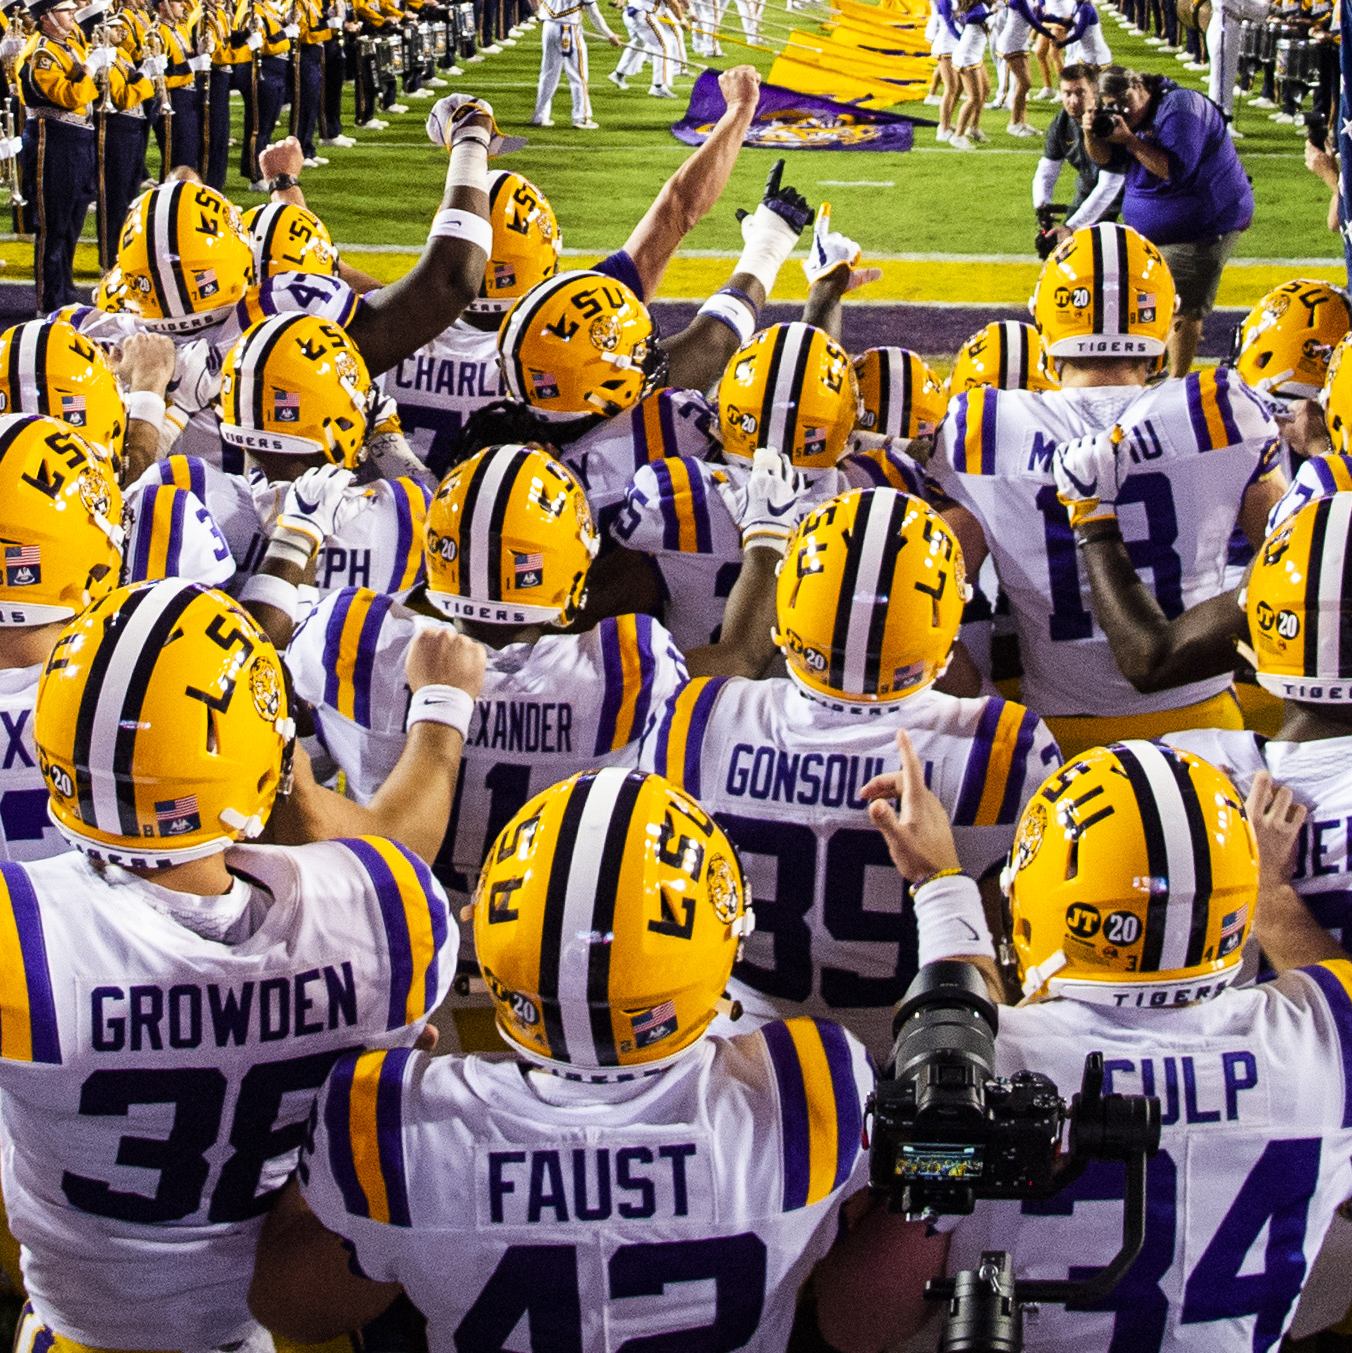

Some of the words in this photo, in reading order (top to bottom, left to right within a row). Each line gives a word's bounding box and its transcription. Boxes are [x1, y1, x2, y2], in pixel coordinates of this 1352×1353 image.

[194, 186, 221, 236] LS
[506, 186, 536, 235] LS
[547, 286, 625, 339] LSU
[1072, 290, 1088, 308] 20
[296, 324, 351, 361] LS
[1077, 341, 1146, 354] TIGERS
[226, 432, 283, 450] TIGERS
[743, 415, 757, 434] 20
[21, 431, 93, 500] LS
[441, 538, 458, 561] 20
[914, 519, 953, 601] LS
[442, 600, 524, 622] TIGERS
[1257, 605, 1273, 628] JT
[1278, 613, 1297, 637] 20
[185, 610, 259, 713] LS
[788, 630, 803, 652] JT
[806, 649, 824, 671] 20
[467, 701, 572, 753] XANDER
[53, 765, 72, 797] 20
[726, 743, 933, 813] GONSOUL
[1067, 908, 1100, 935] JT
[1108, 915, 1139, 944] 20
[91, 961, 359, 1052] GROWDEN
[512, 993, 536, 1024] 20
[1113, 980, 1228, 1008] TIGERS
[487, 1144, 697, 1224] FAUST
